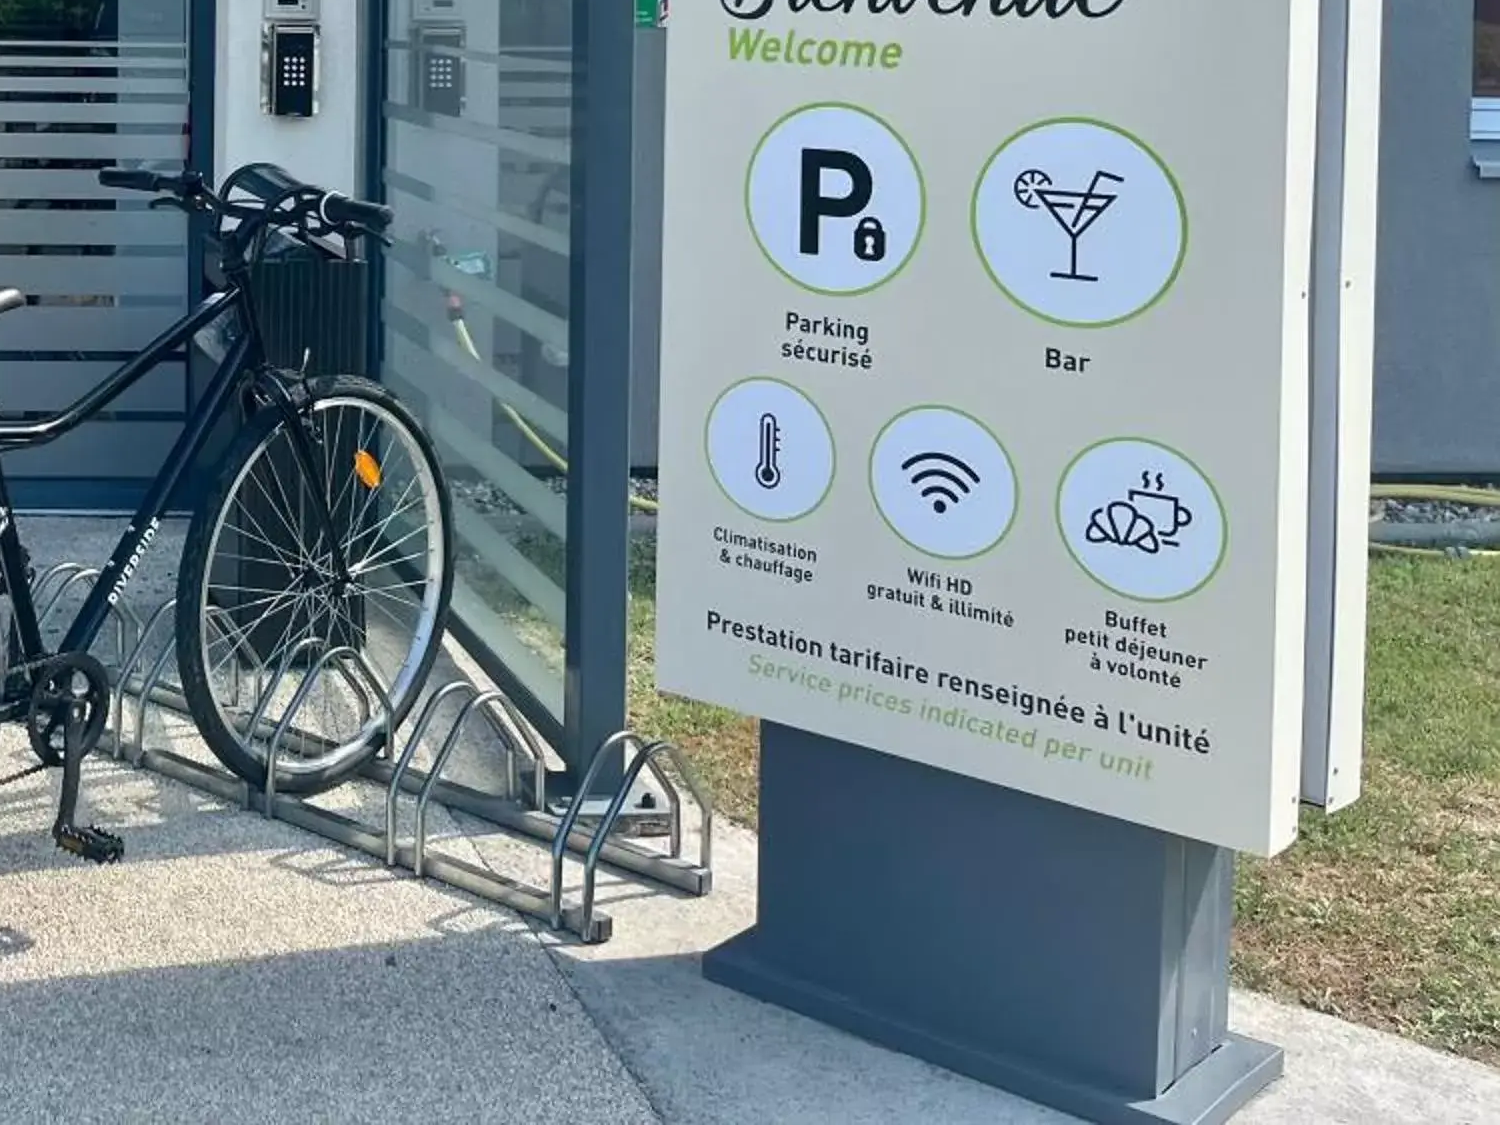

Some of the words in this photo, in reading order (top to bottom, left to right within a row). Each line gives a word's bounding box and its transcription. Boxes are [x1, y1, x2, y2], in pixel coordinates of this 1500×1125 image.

[728, 27, 903, 69] Welcome
[799, 147, 874, 255] P
[785, 312, 869, 346] Parking
[781, 338, 873, 370] sécurisé
[1045, 346, 1092, 373] Bar
[713, 526, 818, 564] Climatisation
[719, 548, 732, 564] &
[735, 553, 814, 584] chauffage
[907, 567, 942, 589] Wifi
[946, 576, 973, 596] HD
[866, 582, 925, 609] gratuit
[930, 594, 944, 612] &
[948, 598, 1015, 628] illimité
[1104, 610, 1168, 639] Buffet
[1064, 627, 1110, 650] petit
[1115, 637, 1209, 671] déjeuner
[707, 609, 823, 658] Prestation
[829, 642, 929, 685] tarifaire
[937, 672, 1085, 724] renseignée
[1093, 704, 1109, 730] à
[1119, 711, 1211, 755] l'unité
[1089, 652, 1101, 671] à
[1107, 660, 1182, 688] volonté
[748, 653, 832, 693] Service
[838, 682, 912, 715] prices
[919, 699, 1037, 749] indicated
[1043, 737, 1092, 759] per
[1099, 751, 1156, 781] unit
